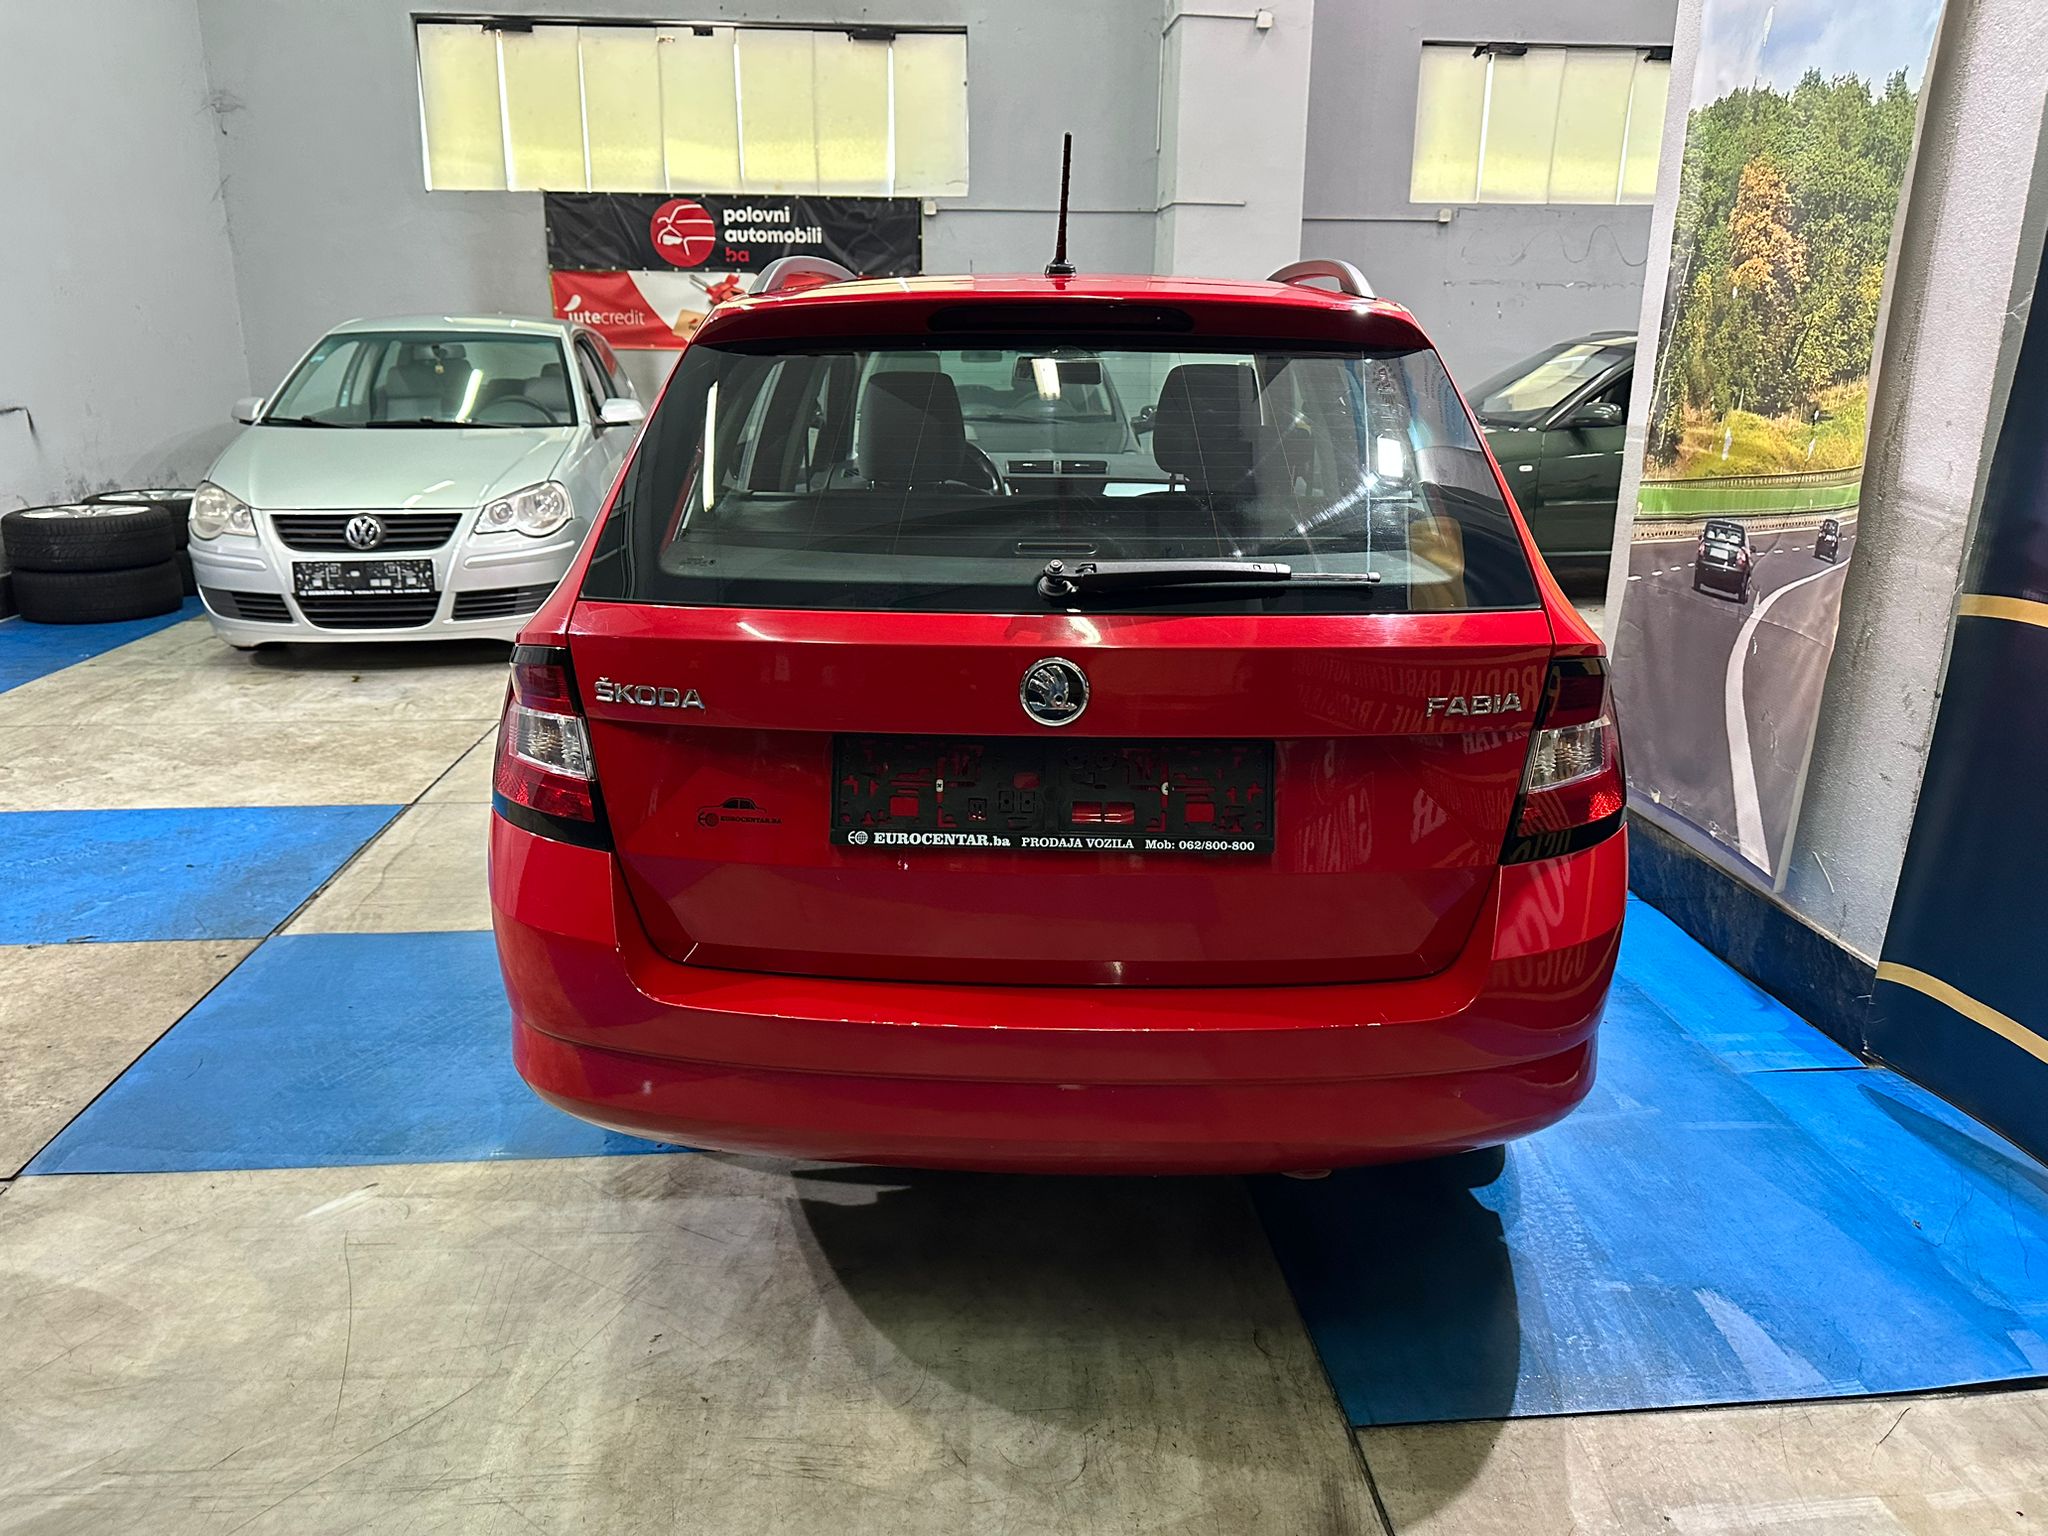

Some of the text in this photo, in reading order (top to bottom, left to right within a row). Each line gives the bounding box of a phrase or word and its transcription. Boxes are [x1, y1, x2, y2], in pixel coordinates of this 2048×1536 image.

[723, 205, 791, 226] polovni
[724, 226, 822, 244] automobili
[594, 676, 706, 710] ŠKODA
[1426, 692, 1522, 718] FABIA
[873, 832, 1255, 851] EUROCENTAR.ba PRODAJA VOZILA Mob: 062/800-800
